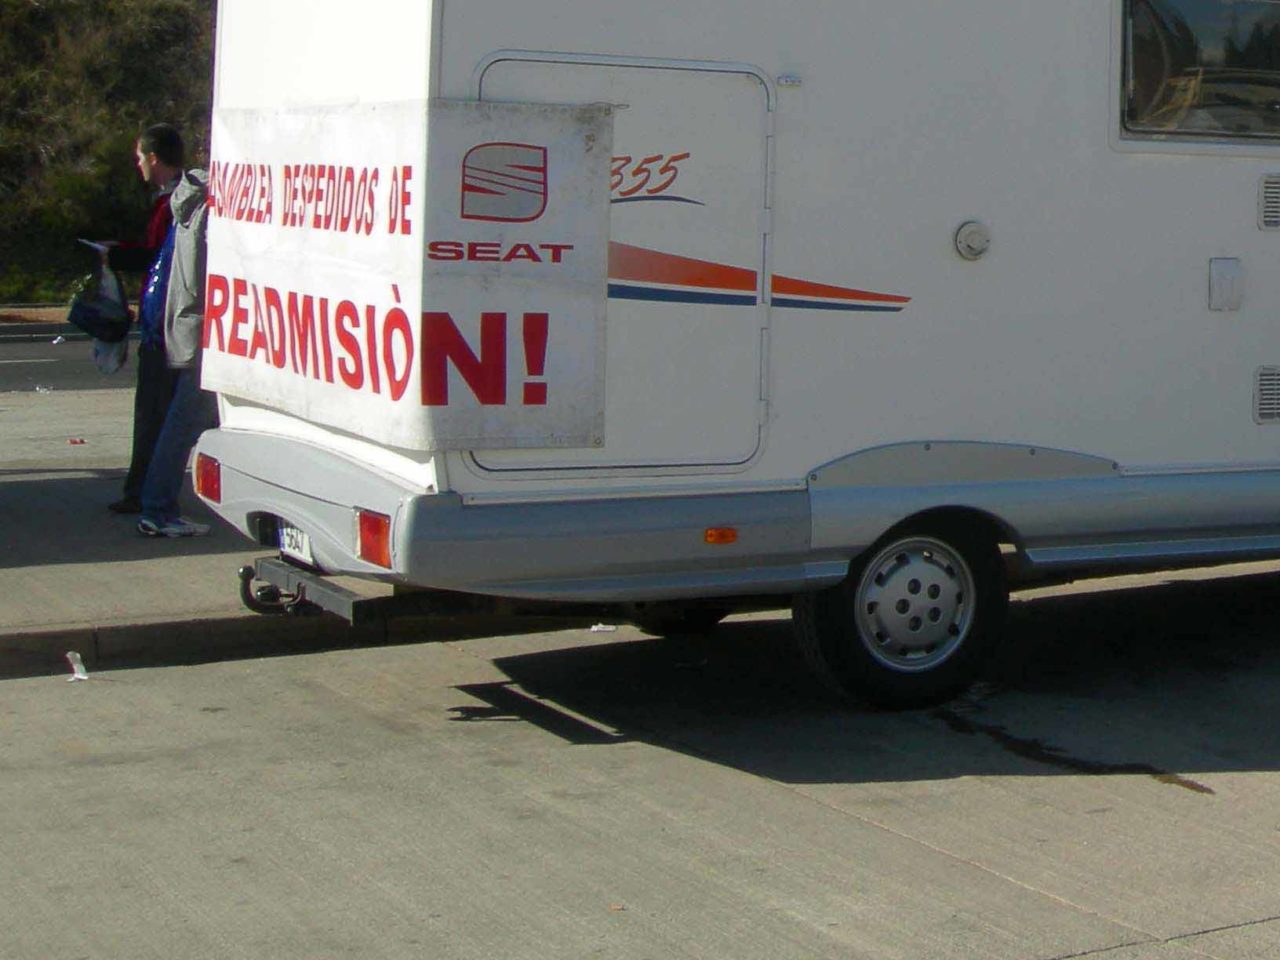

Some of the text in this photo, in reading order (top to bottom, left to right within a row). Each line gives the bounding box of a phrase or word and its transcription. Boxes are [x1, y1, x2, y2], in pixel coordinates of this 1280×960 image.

[611, 152, 690, 196] 355
[207, 160, 574, 263] ASAMBLEA DESPEDIDOS DE SEAT
